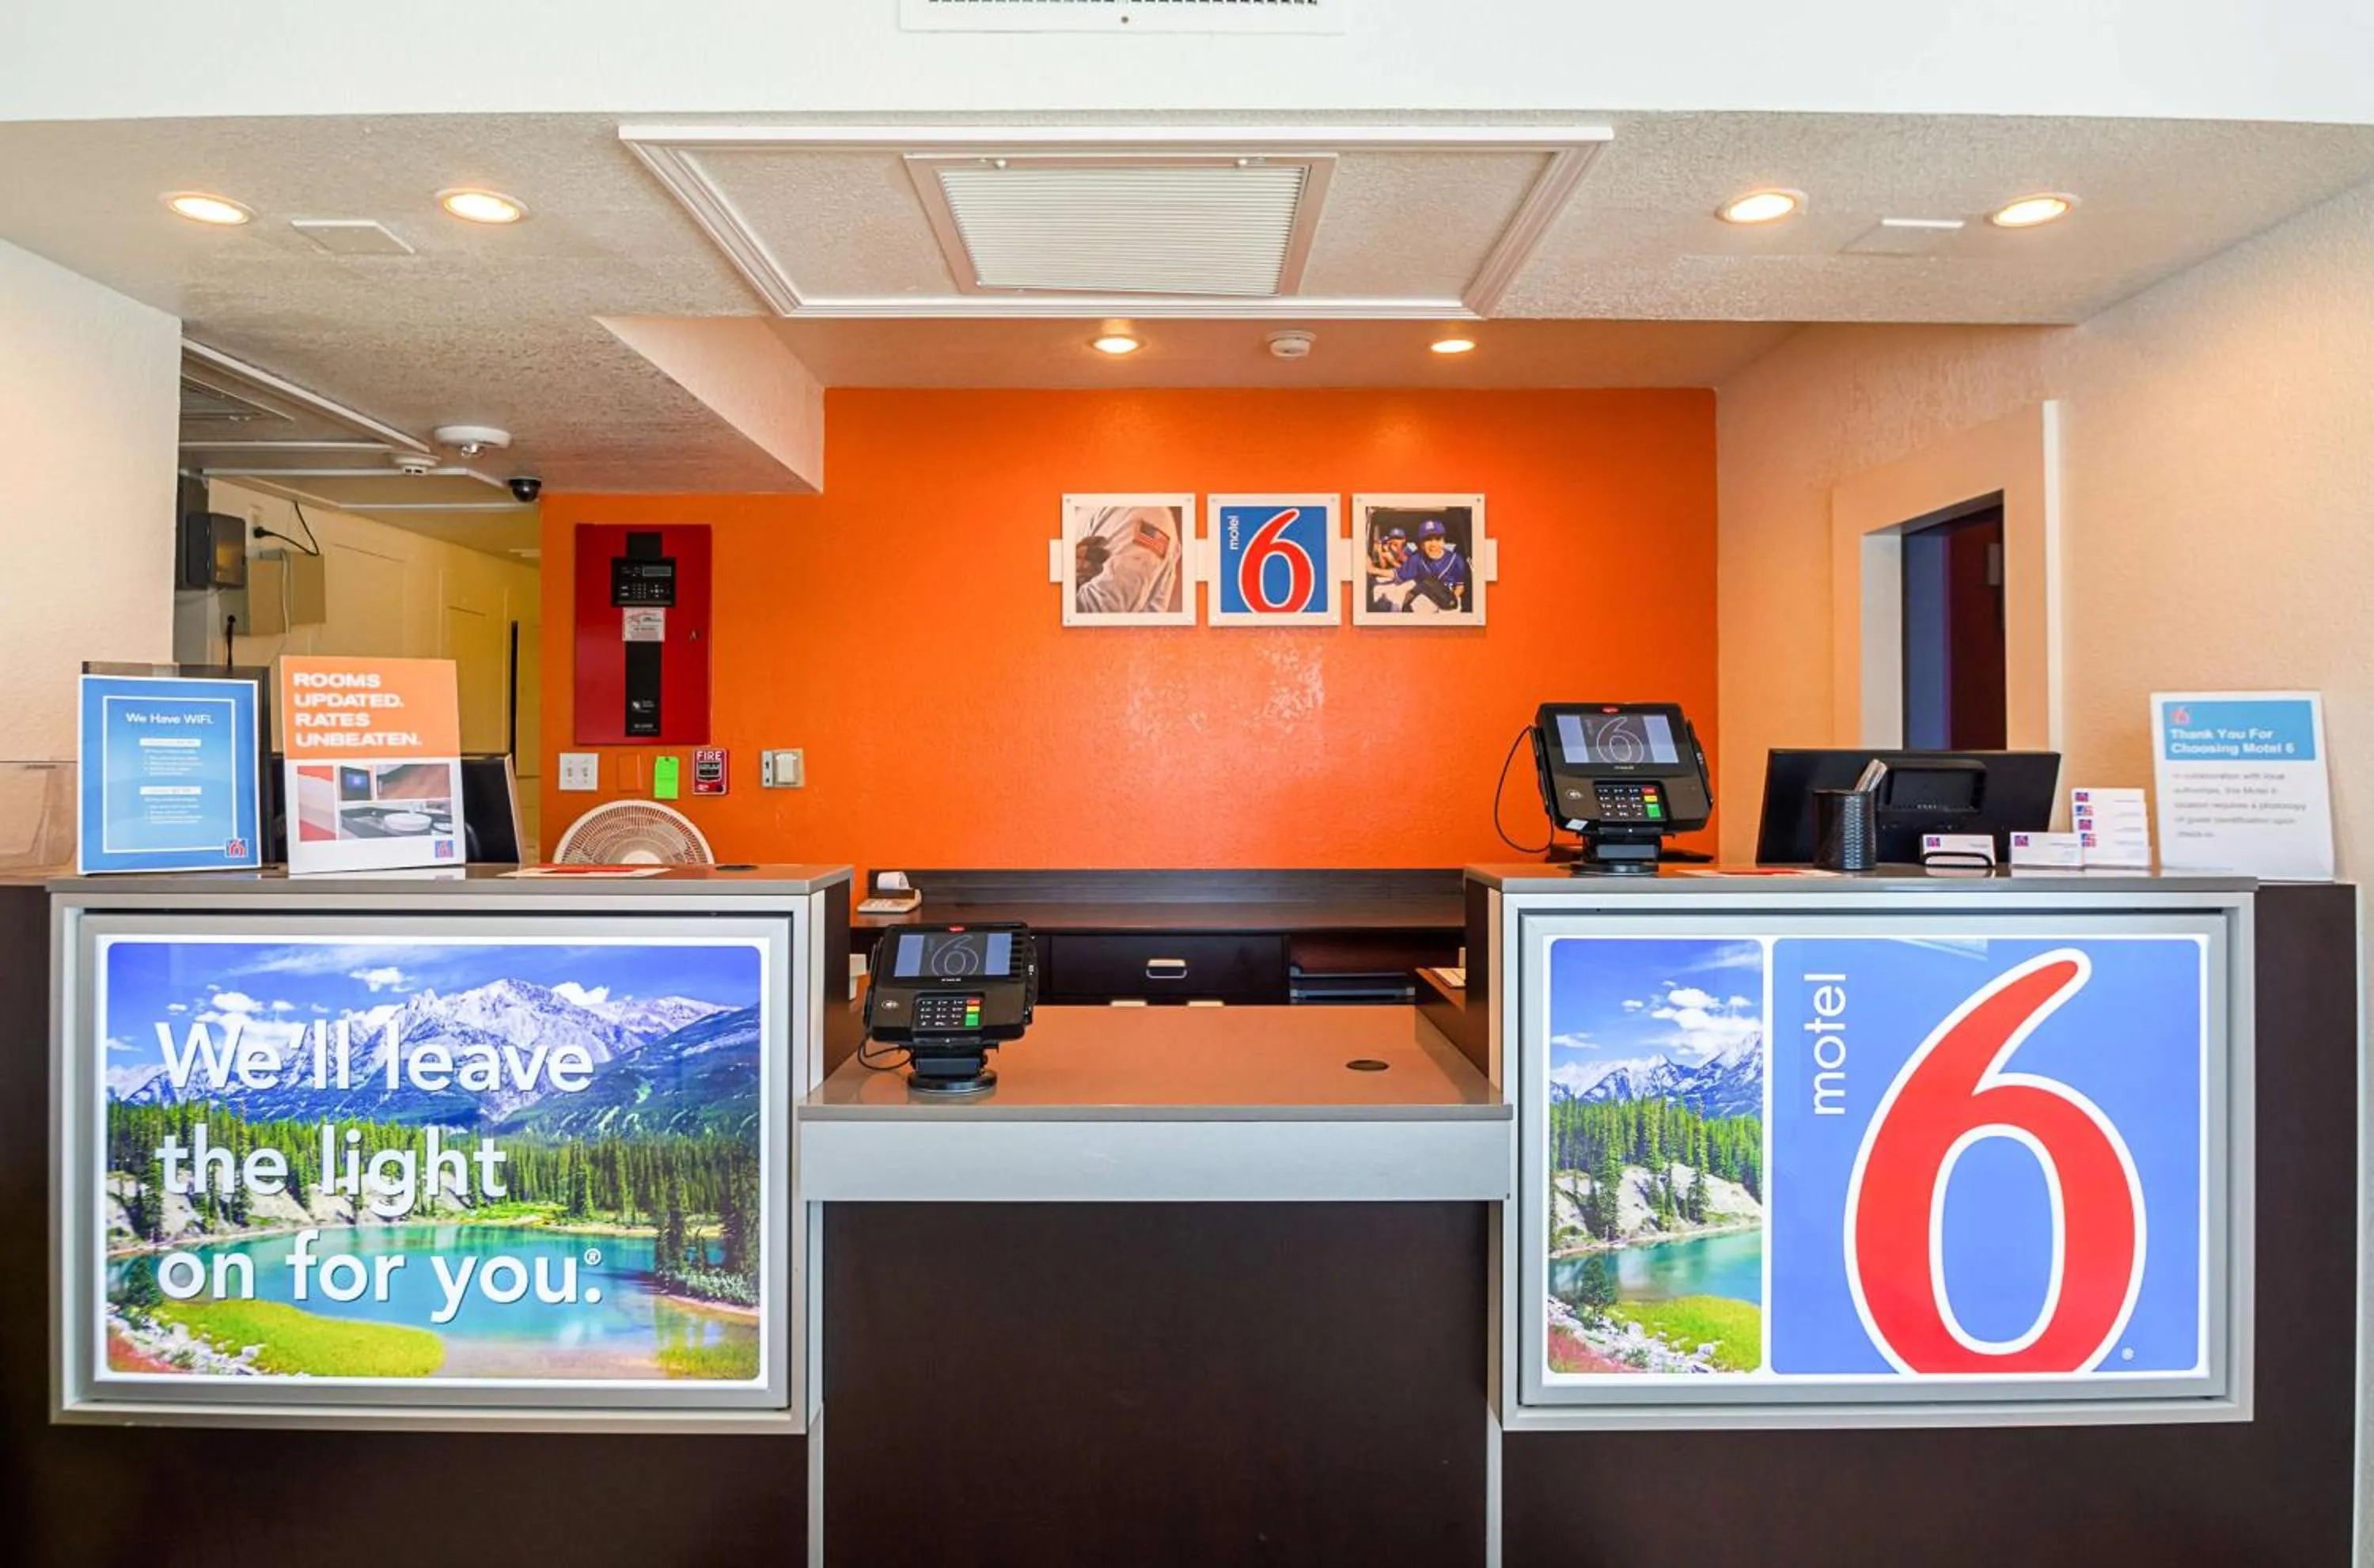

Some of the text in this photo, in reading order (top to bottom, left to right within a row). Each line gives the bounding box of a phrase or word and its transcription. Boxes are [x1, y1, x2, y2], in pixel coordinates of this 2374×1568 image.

[1227, 515, 1239, 550] motel
[1238, 508, 1314, 613] 6
[293, 672, 381, 688] ROOMS
[294, 692, 405, 708] UPDATED.
[126, 712, 147, 723] We
[150, 714, 180, 725] Have
[294, 713, 371, 727] RATES
[2171, 728, 2274, 740] Thank You For
[295, 732, 423, 747] UNBEATEN.
[696, 751, 722, 760] FIRE
[1597, 716, 1644, 763] 6
[2171, 742, 2296, 756] Choosing Motel 6
[932, 934, 979, 975] 6
[155, 1020, 594, 1093] We'll leave
[1803, 973, 1846, 1115] motel
[157, 1123, 507, 1218] the light
[1843, 948, 2147, 1375] 6
[157, 1252, 254, 1301] on
[286, 1229, 406, 1302] for
